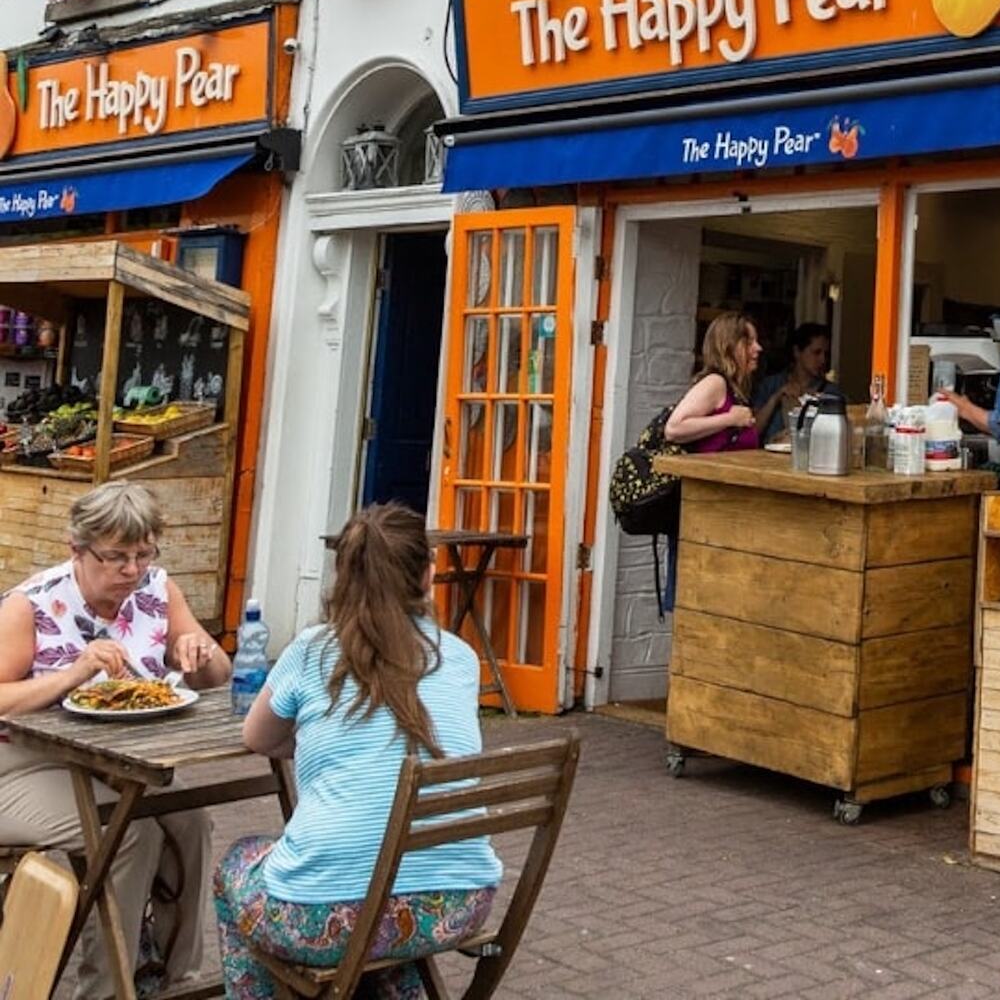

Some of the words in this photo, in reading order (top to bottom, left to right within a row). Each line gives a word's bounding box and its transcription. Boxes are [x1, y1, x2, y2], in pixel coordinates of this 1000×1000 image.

[37, 79, 79, 130] The
[85, 62, 168, 135] Happy
[175, 47, 241, 109] Pear
[682, 138, 709, 163] The
[713, 131, 769, 167] Happy
[773, 126, 815, 155] Pear
